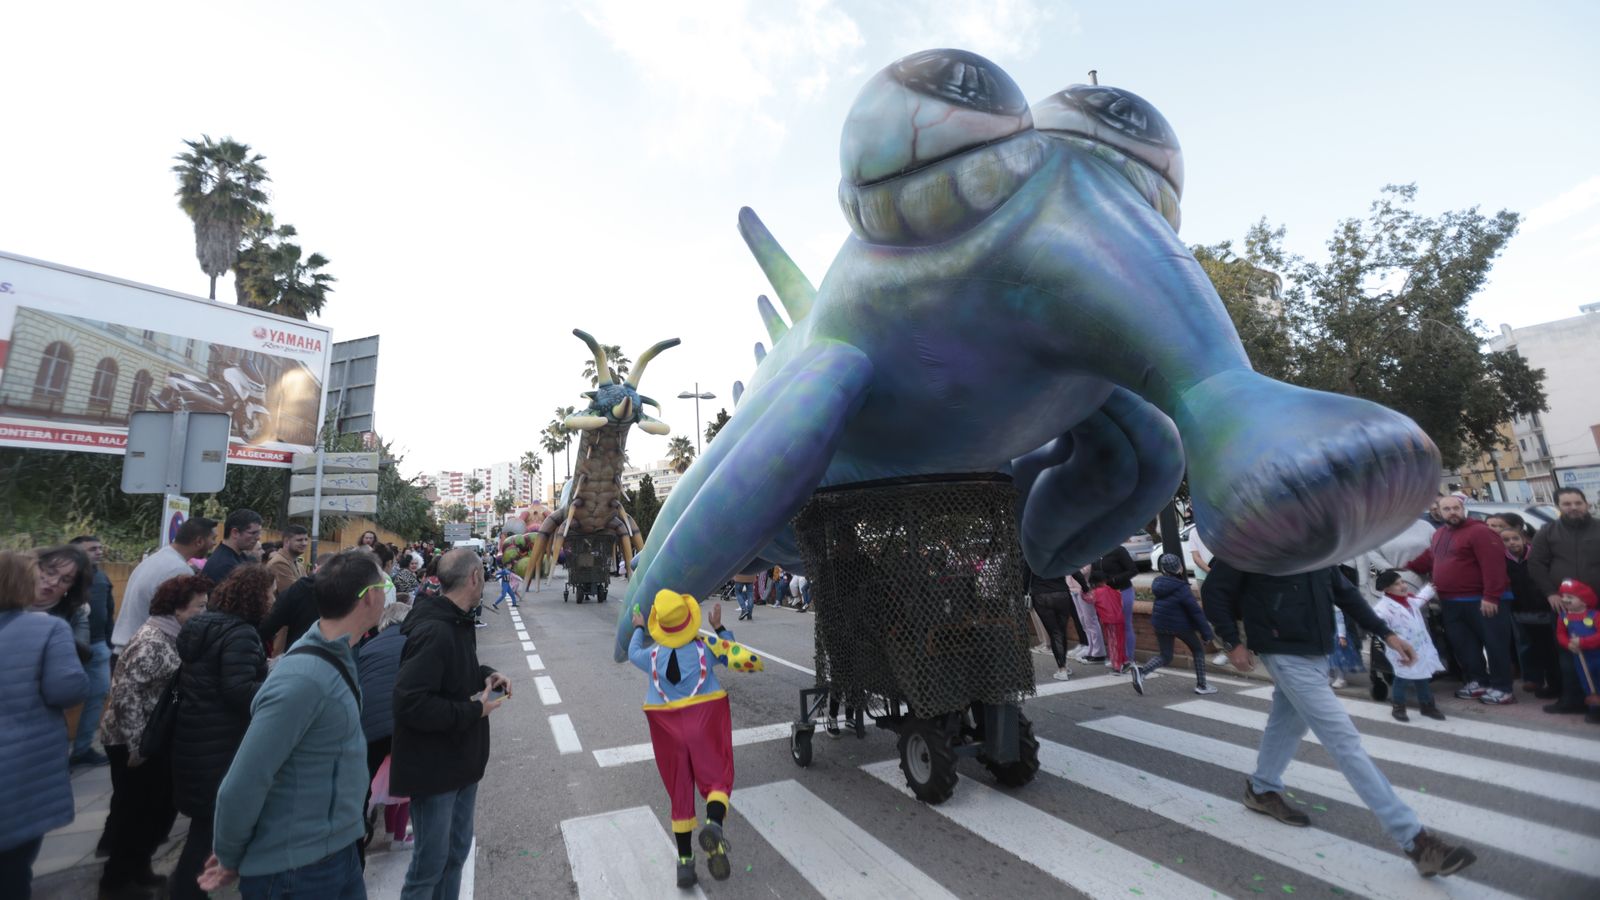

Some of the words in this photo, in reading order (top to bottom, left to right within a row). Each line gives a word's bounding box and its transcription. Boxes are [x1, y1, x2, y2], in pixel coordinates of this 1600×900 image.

[270, 329, 321, 352] YAMAHA
[61, 433, 96, 444] CTRA.
[236, 449, 285, 461] ALGECIRAS
